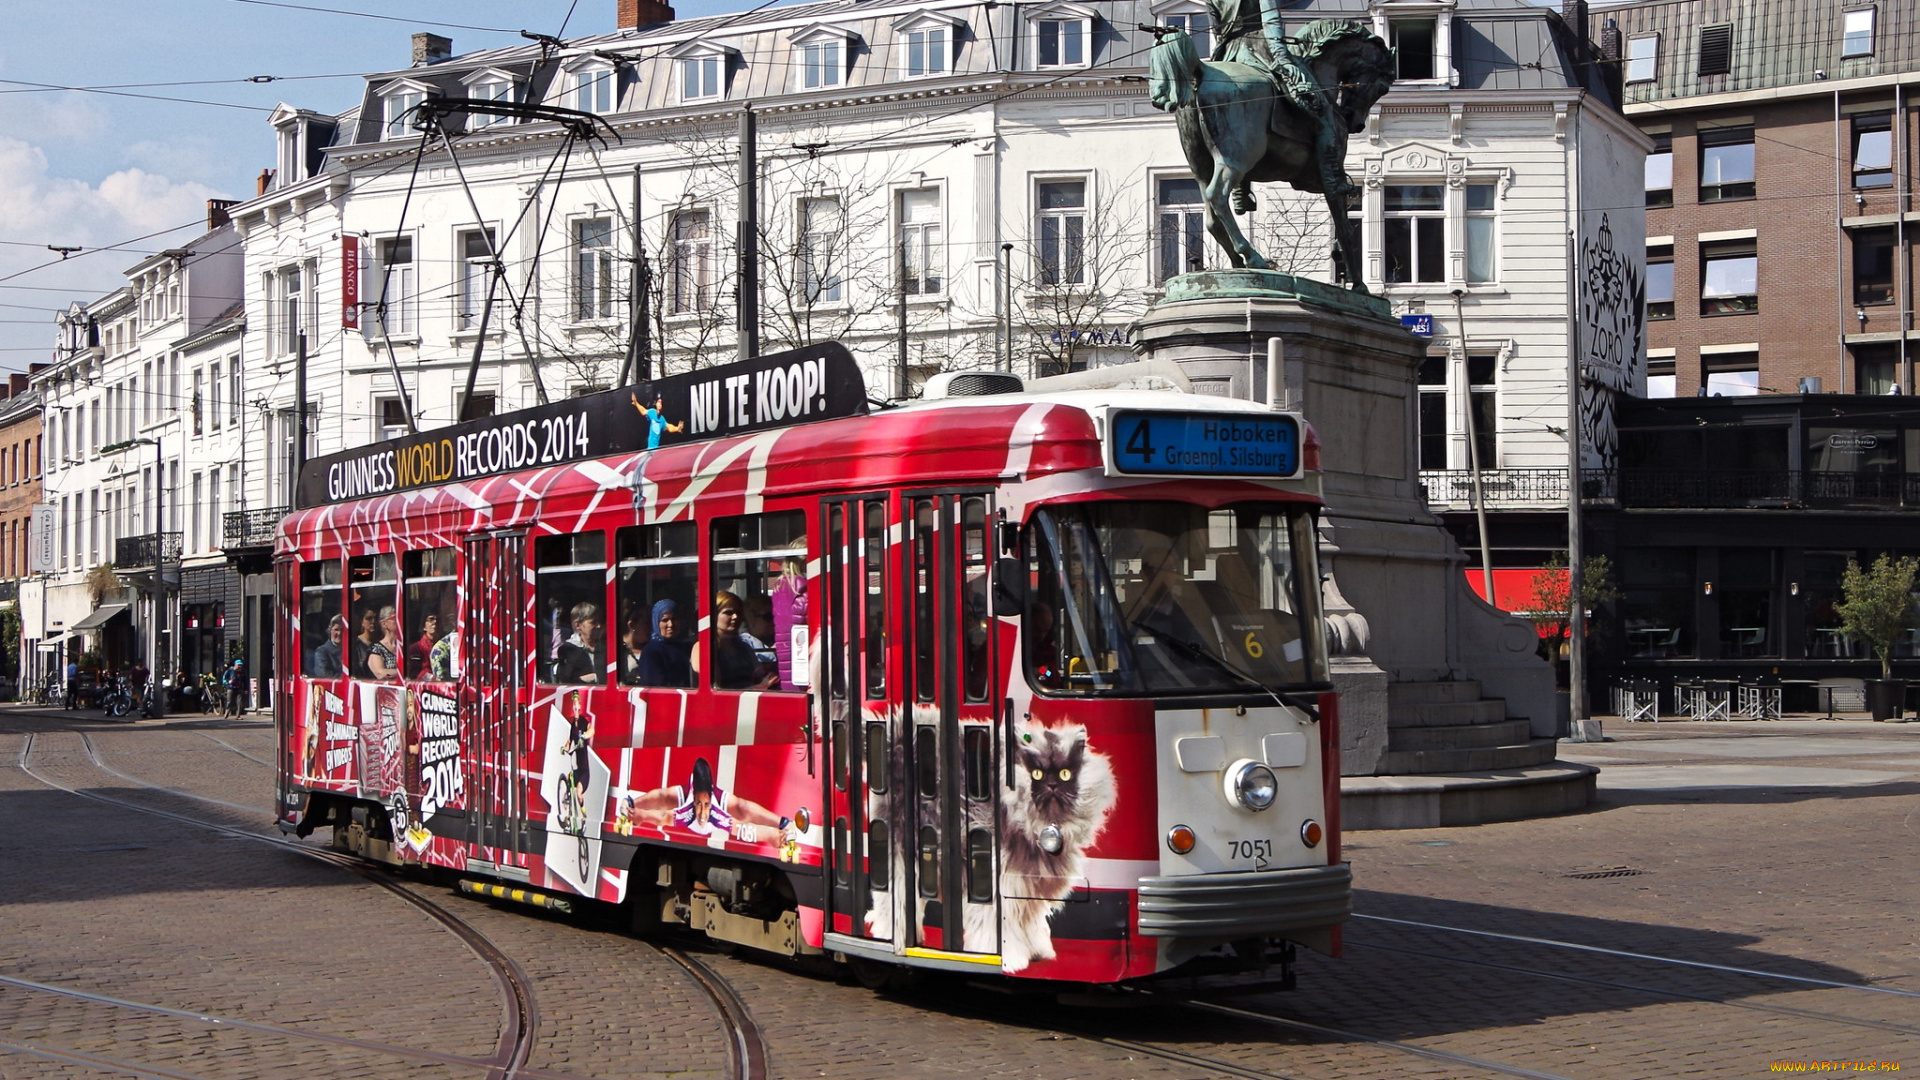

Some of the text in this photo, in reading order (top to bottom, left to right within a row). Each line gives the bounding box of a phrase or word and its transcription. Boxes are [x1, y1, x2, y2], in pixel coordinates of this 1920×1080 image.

[347, 249, 355, 296] BIANCO
[1591, 322, 1623, 366] ZORO
[690, 357, 826, 434] NU TE KOOP!
[1125, 419, 1156, 464] 4
[1204, 422, 1287, 443] Hoboken
[328, 411, 589, 501] GUINNESS WORLD RECORDS 2014
[1165, 445, 1286, 471] Groenpl. Silsburg
[1245, 631, 1263, 658] 6
[421, 692, 457, 715] GUINNESS
[421, 713, 458, 739] WORLD
[422, 739, 460, 764] RECORDS
[421, 757, 464, 823] 2014
[396, 811, 407, 830] 3D
[736, 824, 758, 842] 7051
[1228, 839, 1272, 859] 7051
